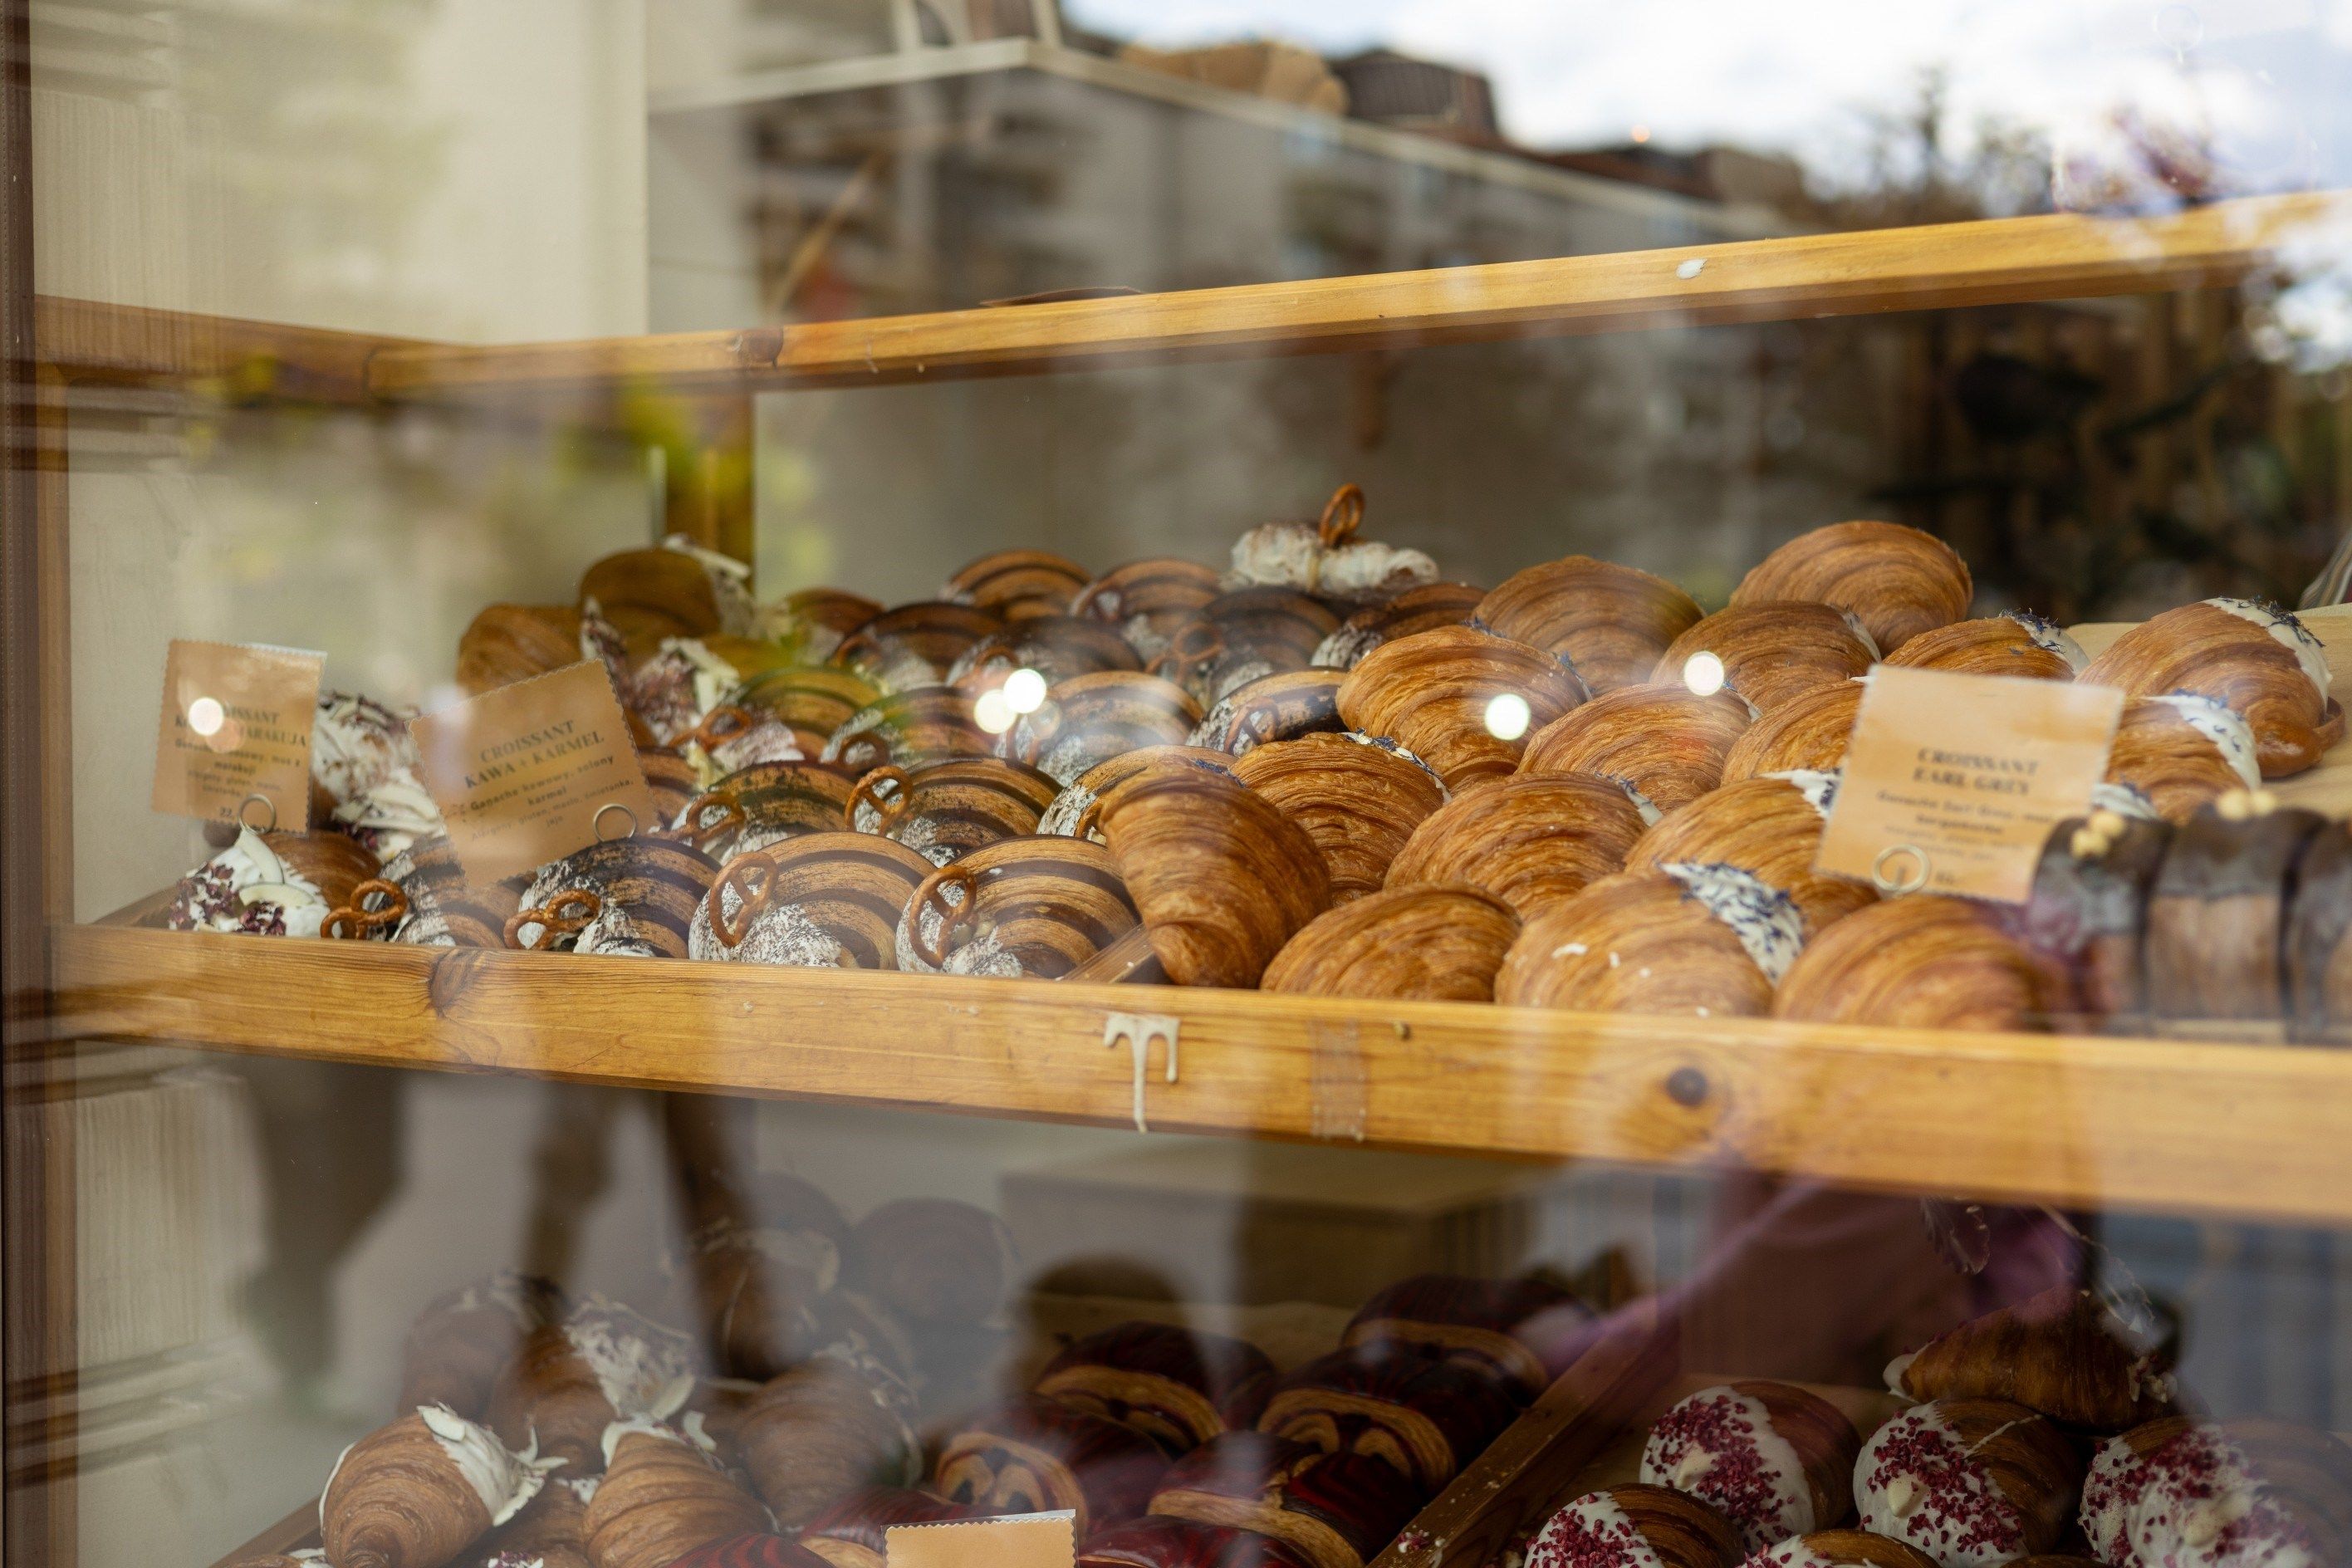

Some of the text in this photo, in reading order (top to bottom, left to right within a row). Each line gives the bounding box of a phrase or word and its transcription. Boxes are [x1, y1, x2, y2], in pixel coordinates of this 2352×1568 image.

[464, 762, 516, 789] KAWA
[532, 731, 605, 765] KARMEL
[480, 719, 574, 763] CROISSANT
